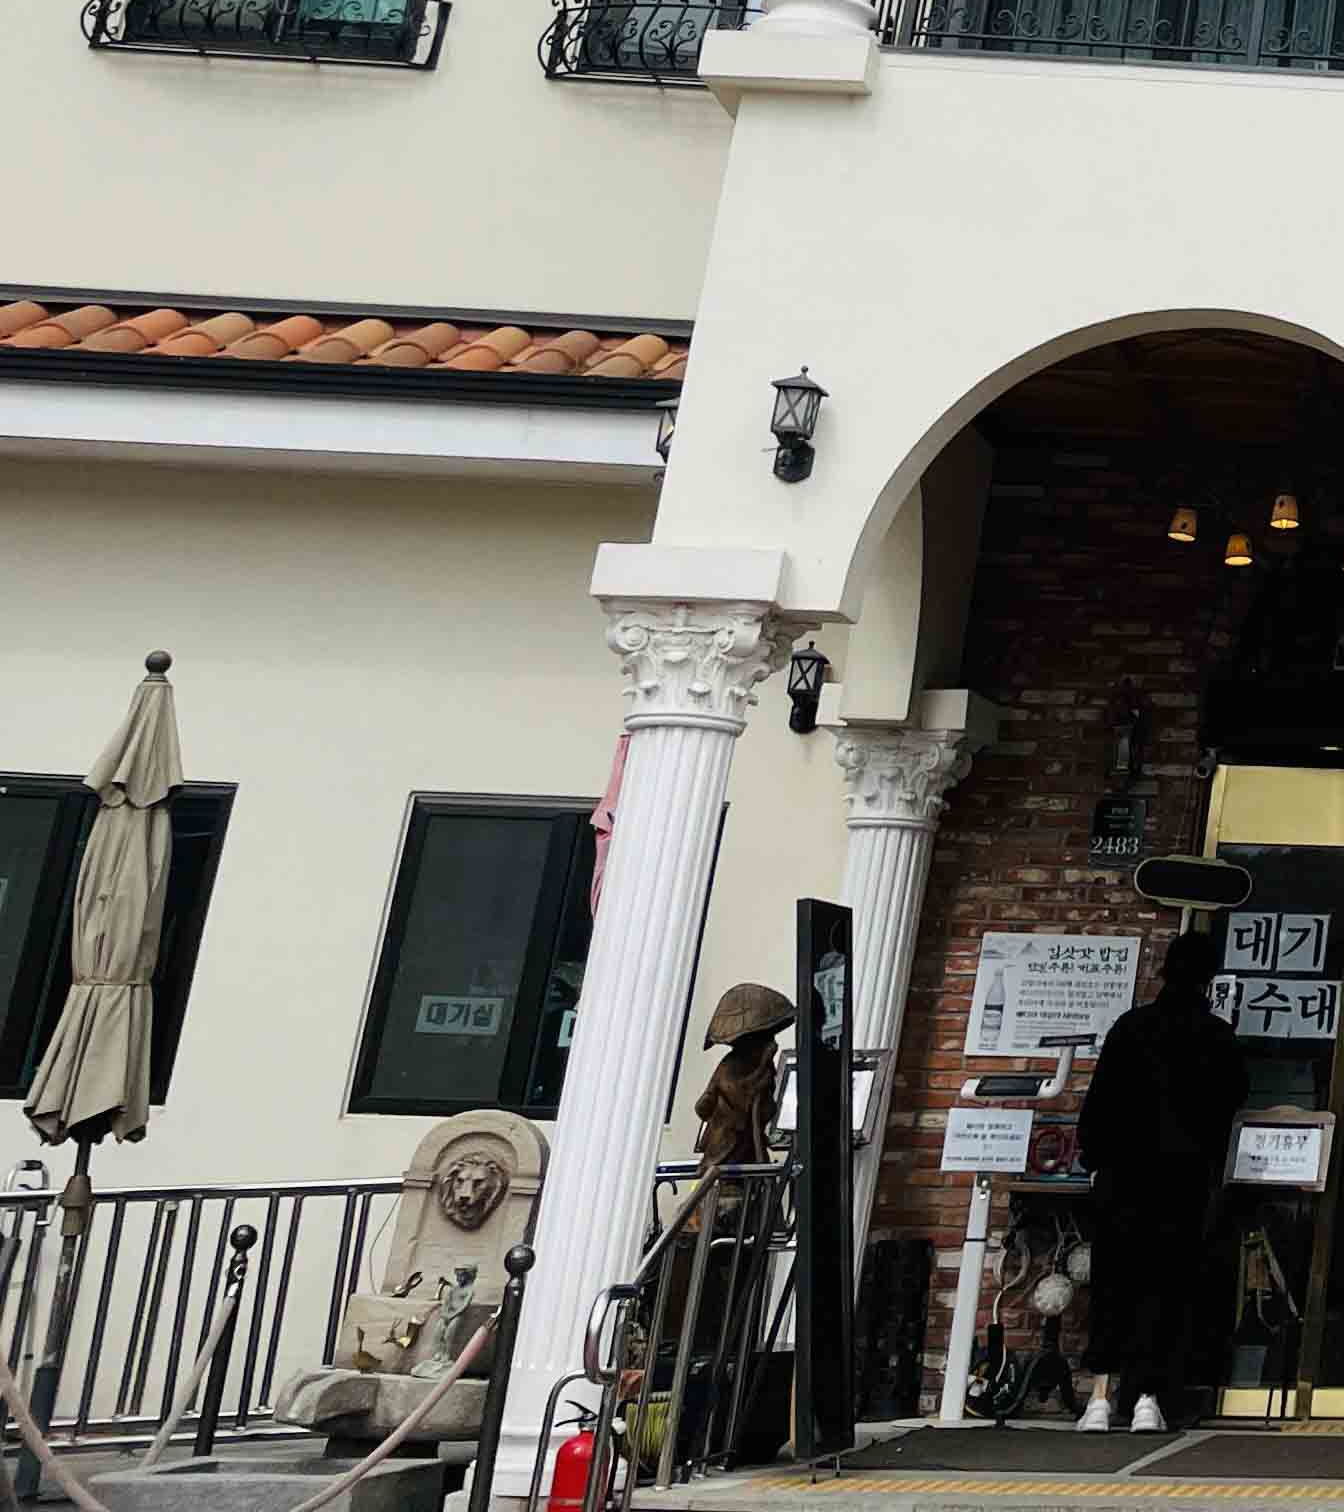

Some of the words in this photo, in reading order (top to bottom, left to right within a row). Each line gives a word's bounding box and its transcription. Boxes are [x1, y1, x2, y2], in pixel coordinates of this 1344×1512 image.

[1090, 835, 1138, 855] 2483
[1233, 917, 1324, 968] 대기
[425, 1001, 495, 1027] 대기실
